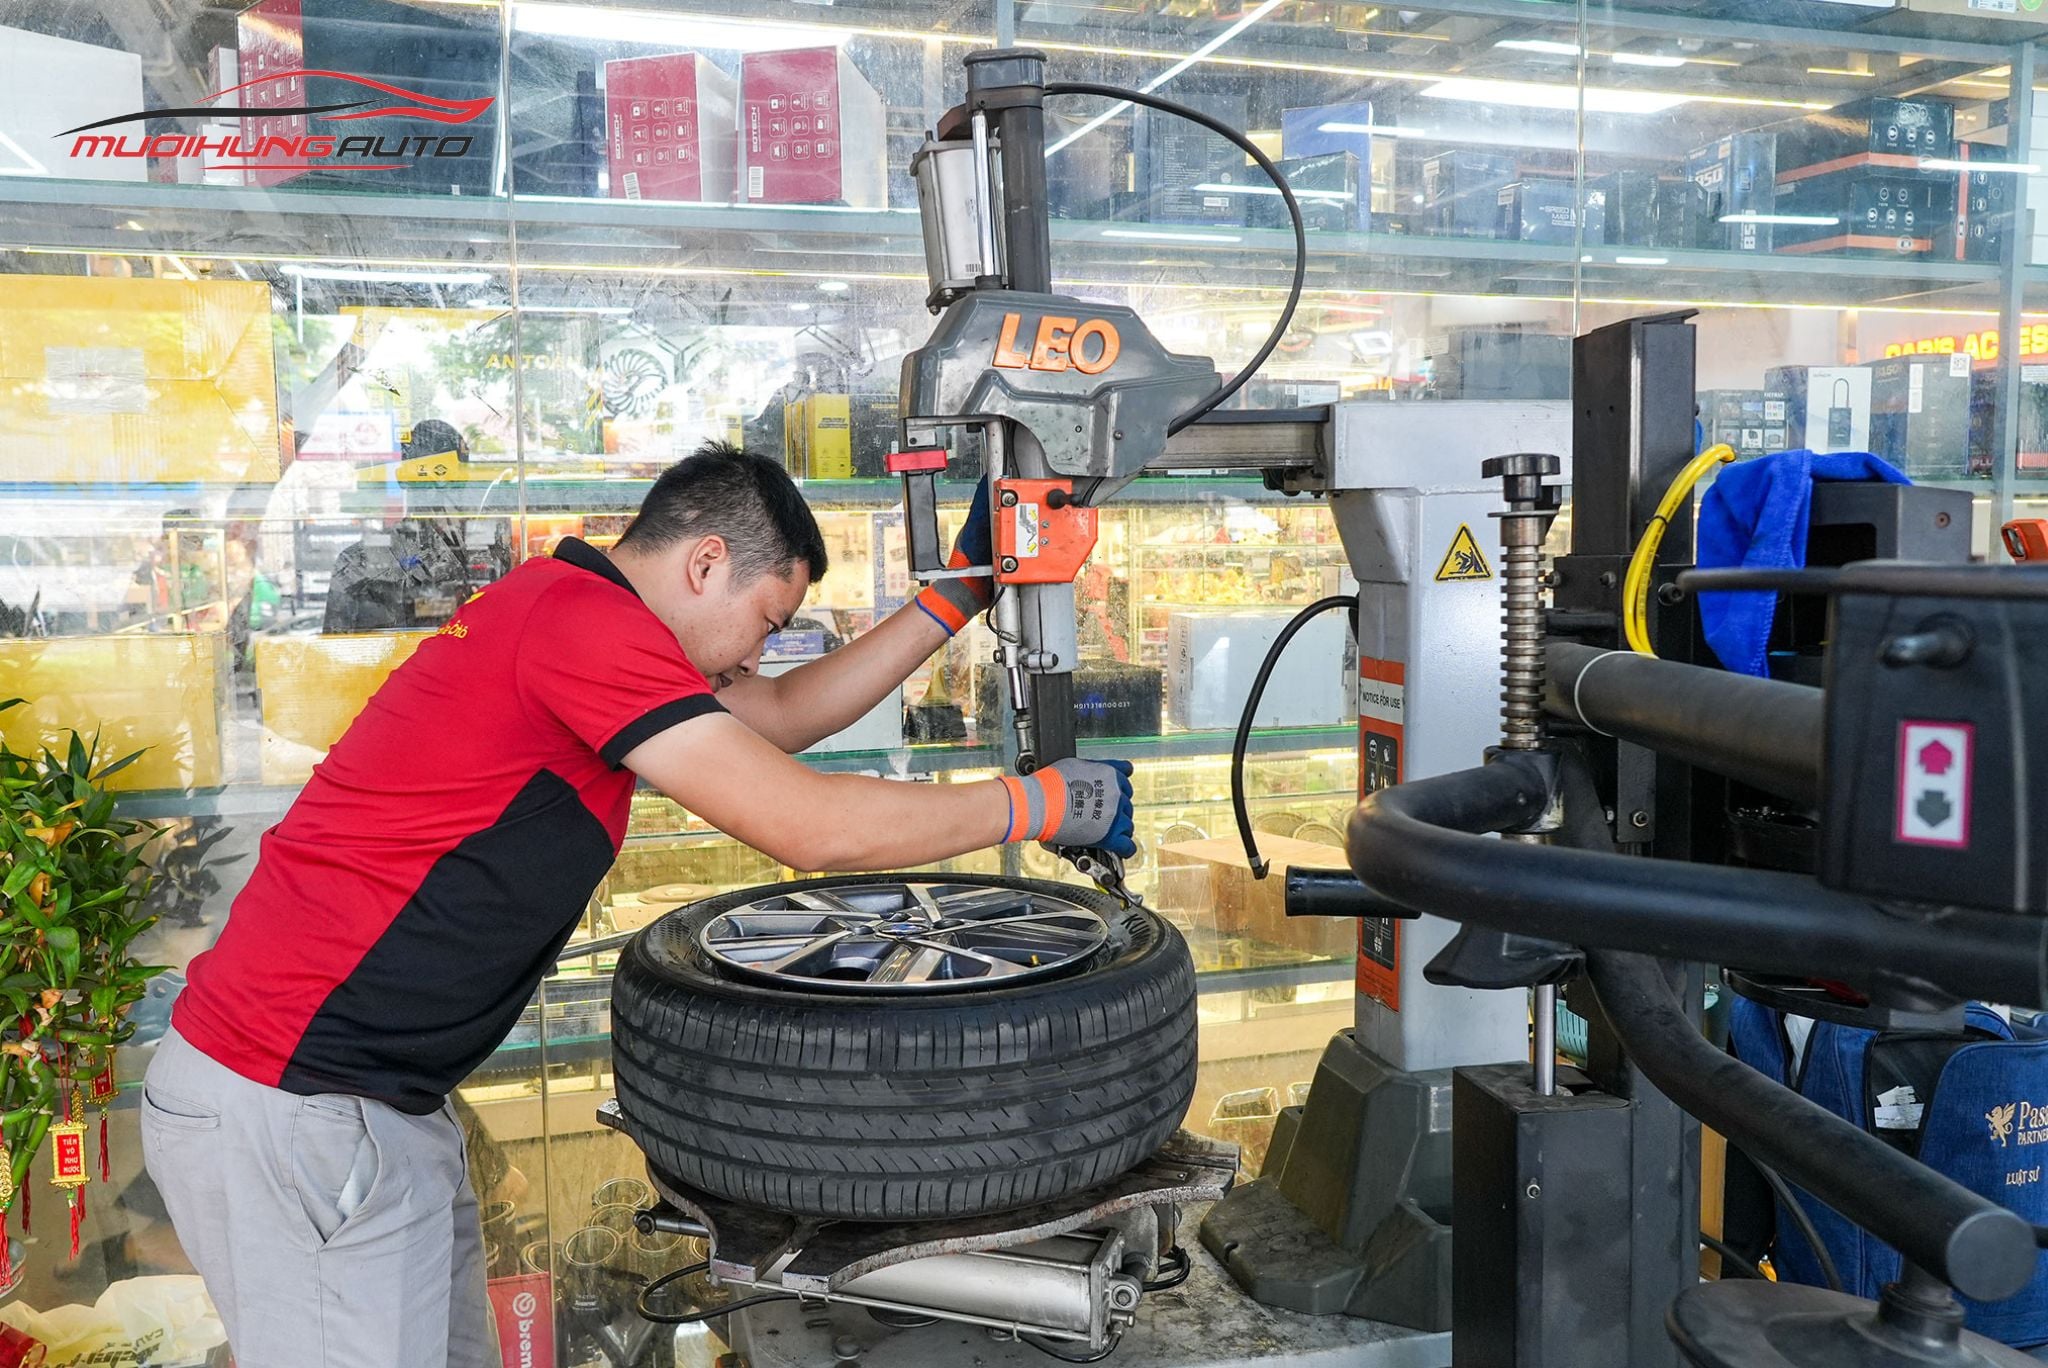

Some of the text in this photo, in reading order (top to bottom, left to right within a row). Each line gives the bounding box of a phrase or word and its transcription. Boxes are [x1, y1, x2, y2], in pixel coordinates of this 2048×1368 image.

[992, 312, 1120, 374] LEO
[485, 352, 516, 369] AN
[1362, 690, 1401, 709] NOTICE FOR USE
